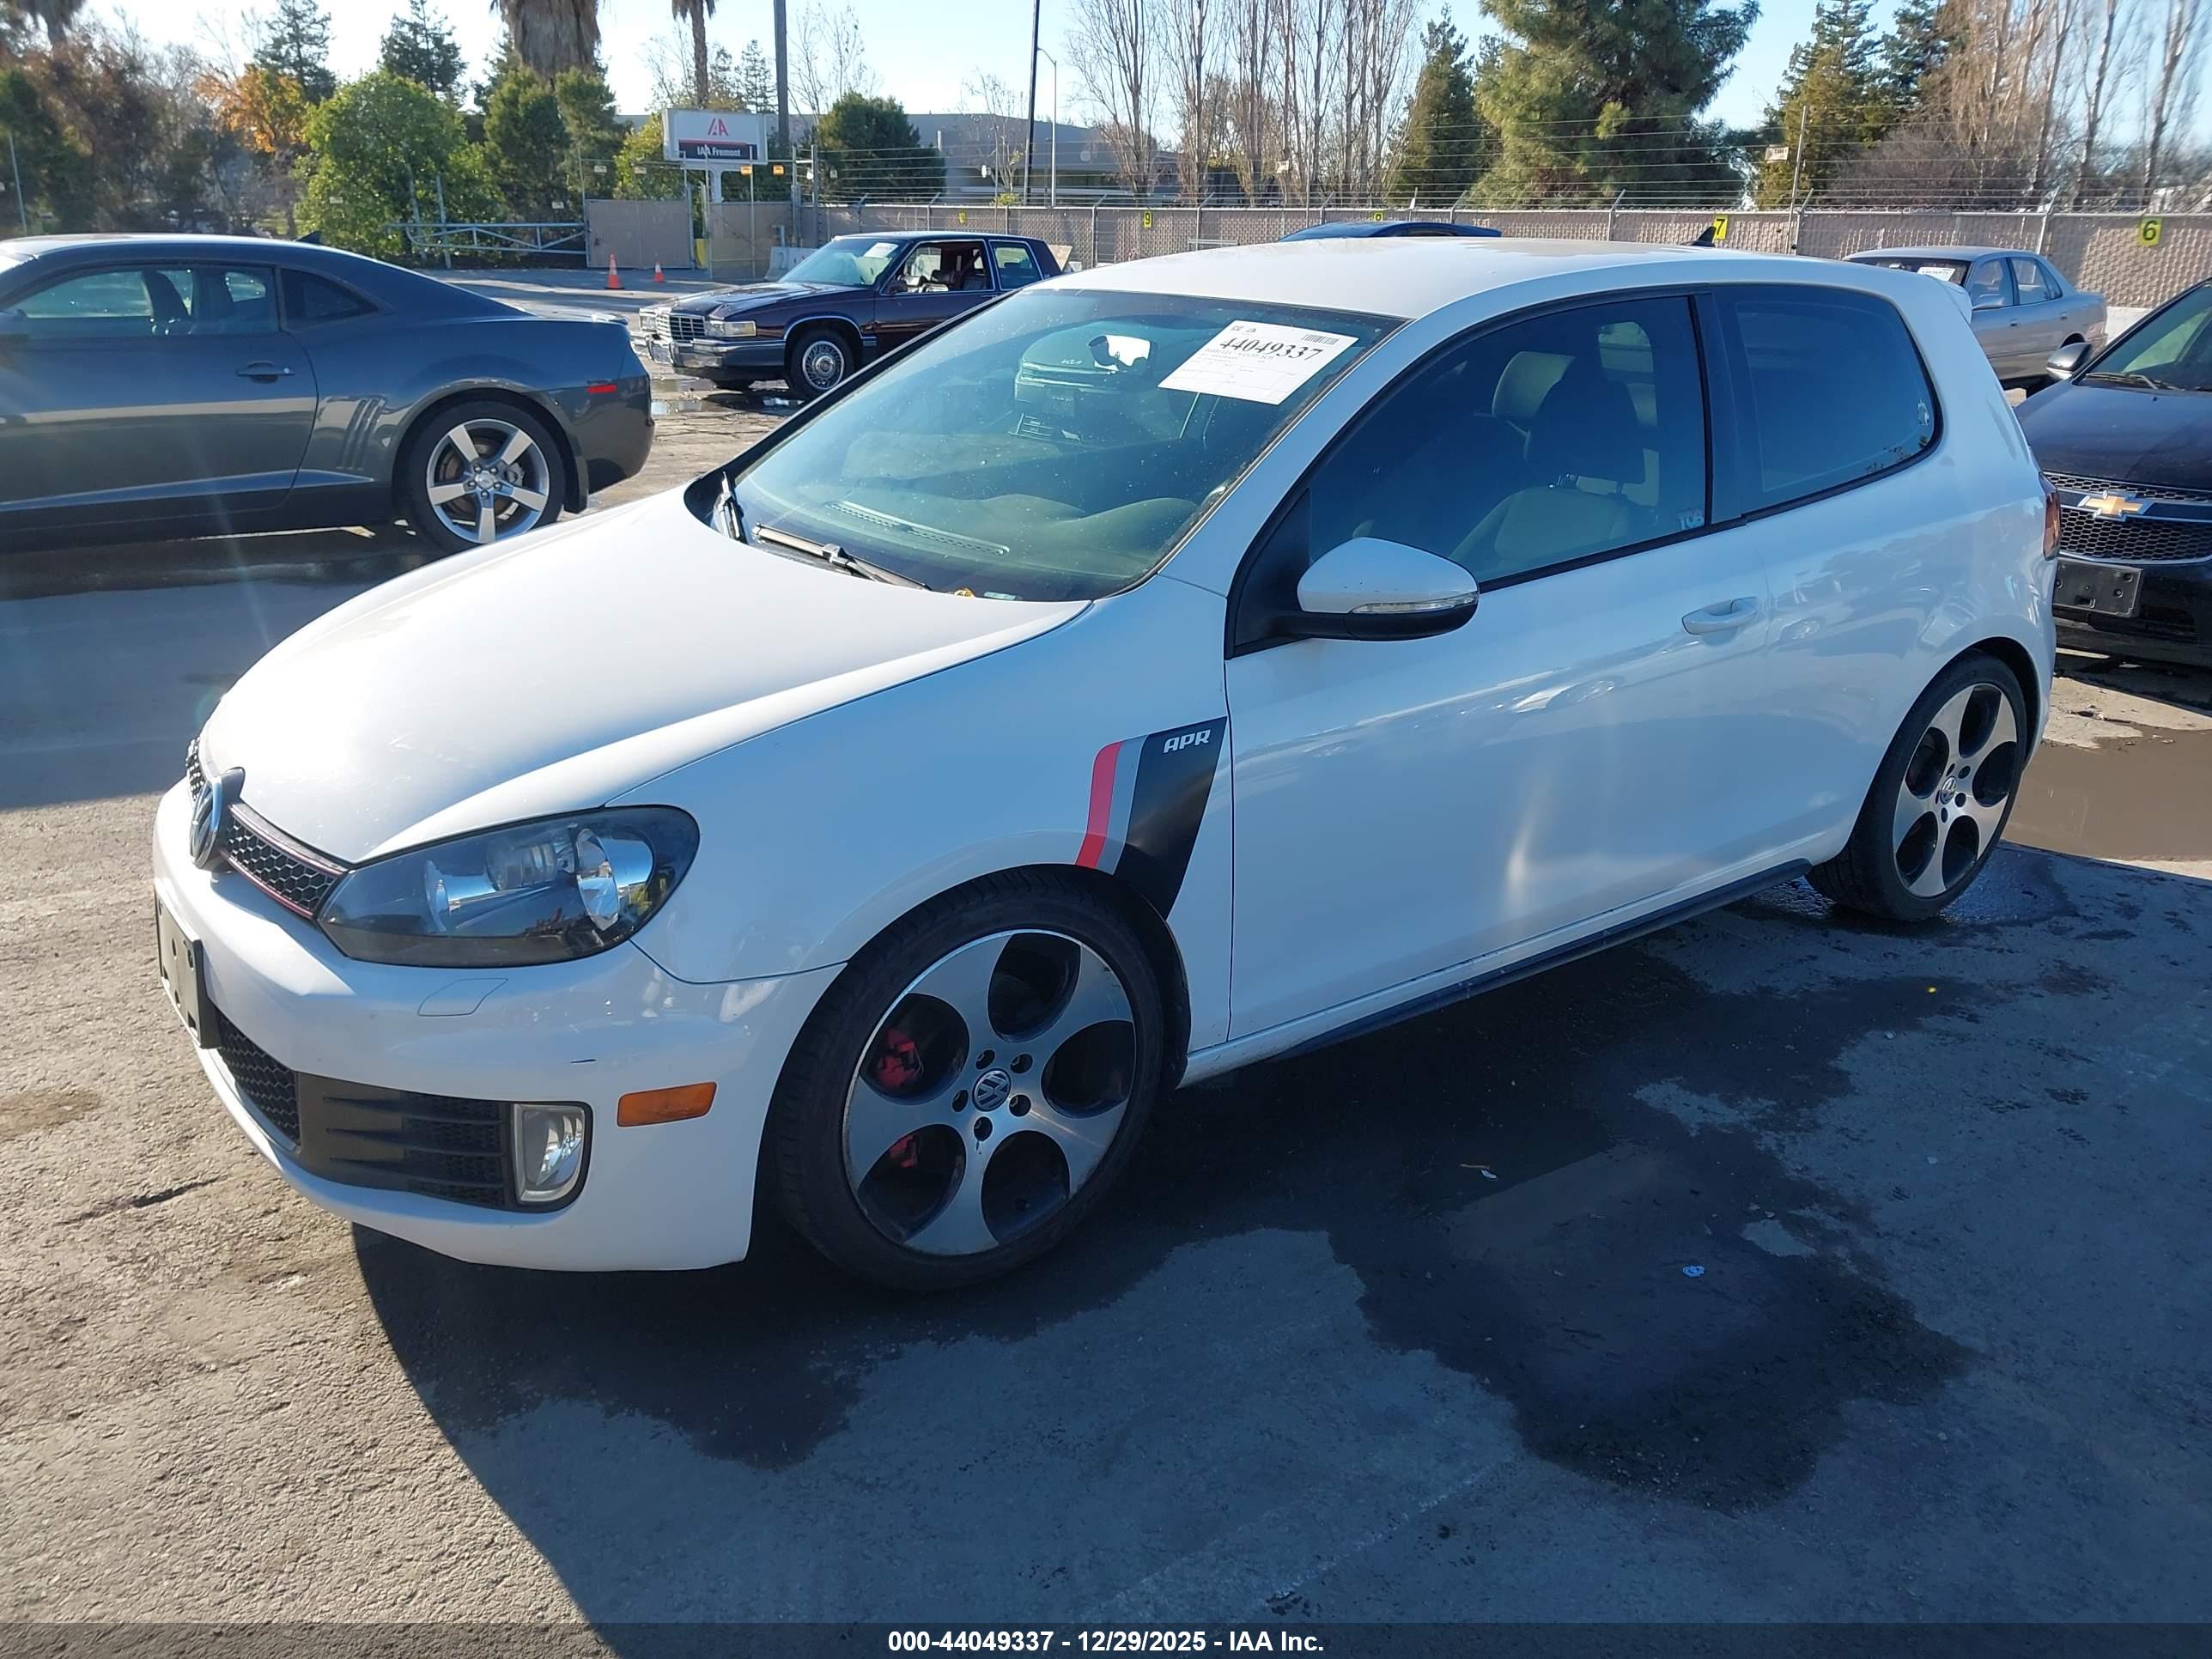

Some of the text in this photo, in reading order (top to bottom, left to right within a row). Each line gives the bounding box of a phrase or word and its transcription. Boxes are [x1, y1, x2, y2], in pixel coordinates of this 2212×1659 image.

[696, 145, 741, 156] IAA Fremont
[1144, 212, 1152, 225] 9
[1716, 218, 1726, 235] 7
[2142, 219, 2158, 241] 6
[1219, 337, 1323, 361] 44049337
[1162, 728, 1212, 754] APR
